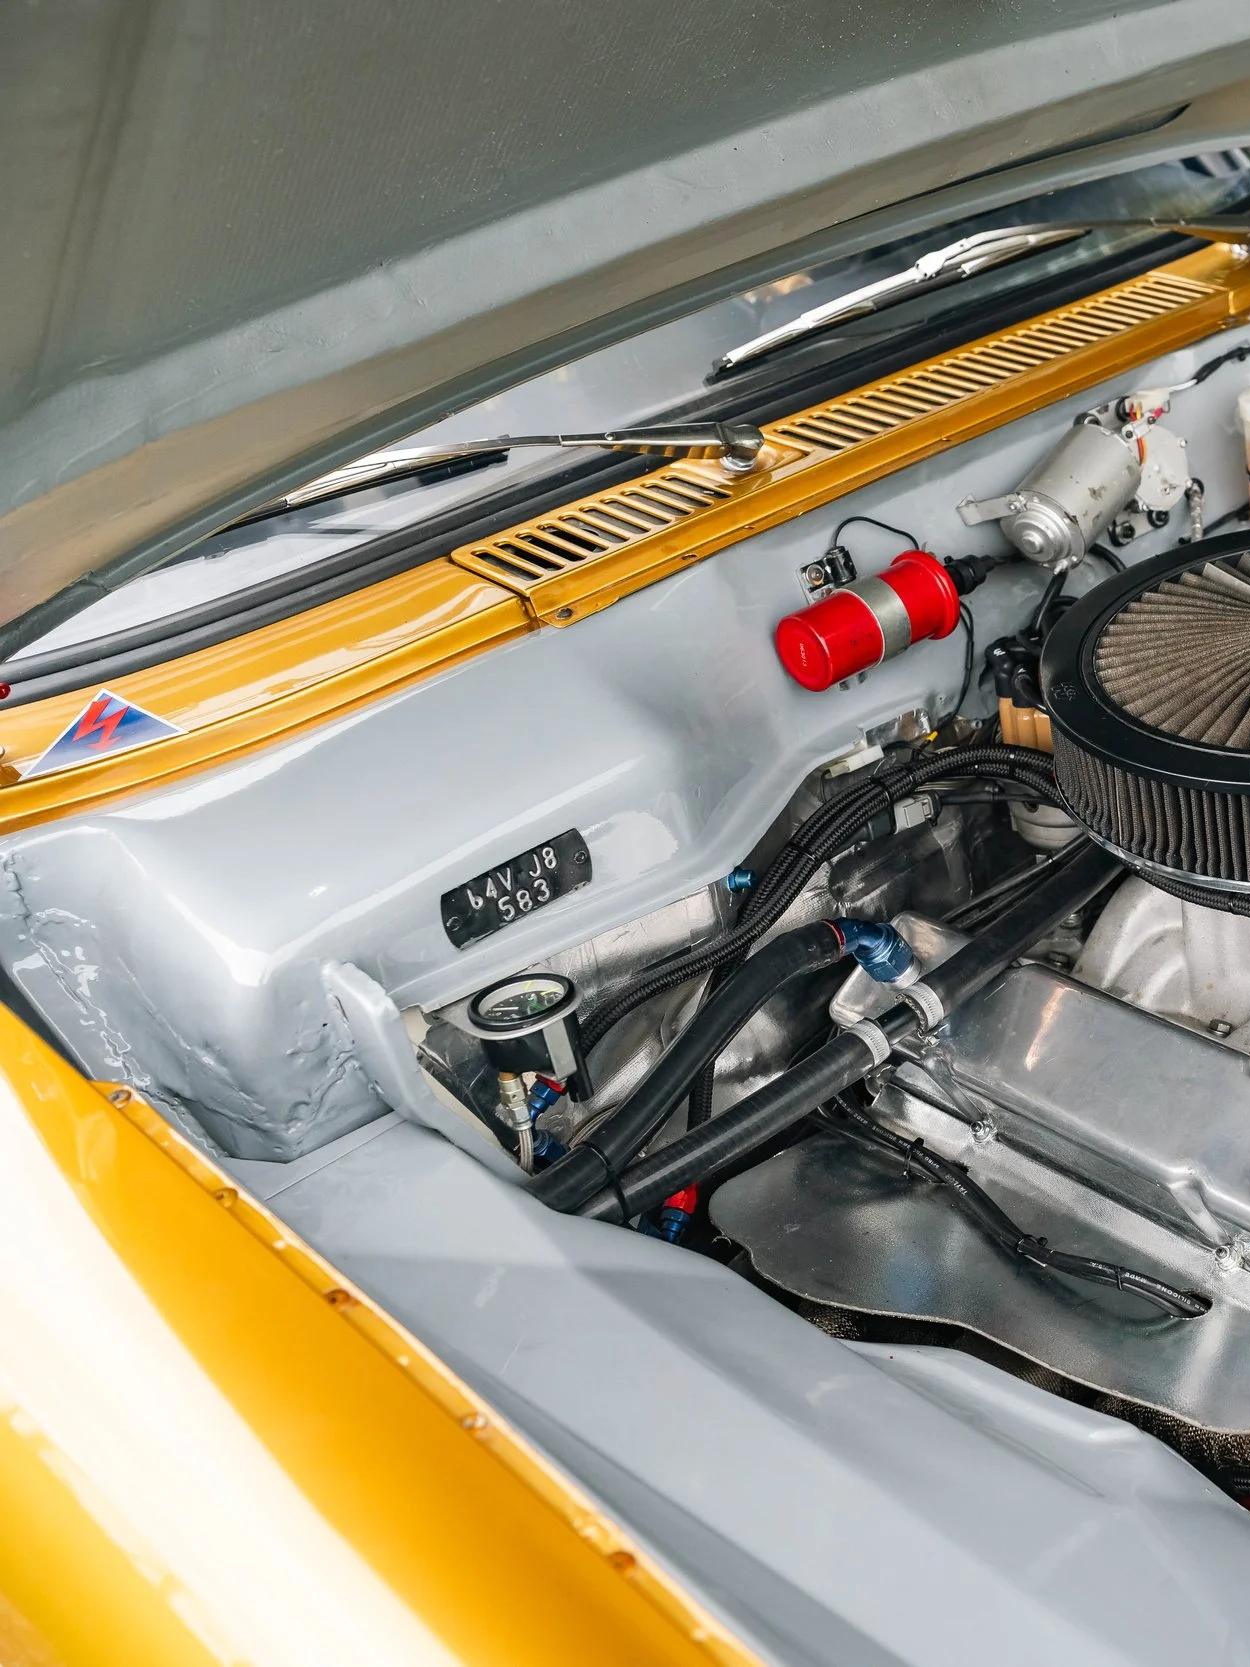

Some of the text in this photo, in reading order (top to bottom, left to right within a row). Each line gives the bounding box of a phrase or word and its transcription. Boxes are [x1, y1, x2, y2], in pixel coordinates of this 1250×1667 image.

[466, 847, 557, 910] 64V J8
[498, 878, 551, 921] 583
[1124, 1271, 1147, 1284] MADE
[1155, 1283, 1191, 1305] SILICONE
